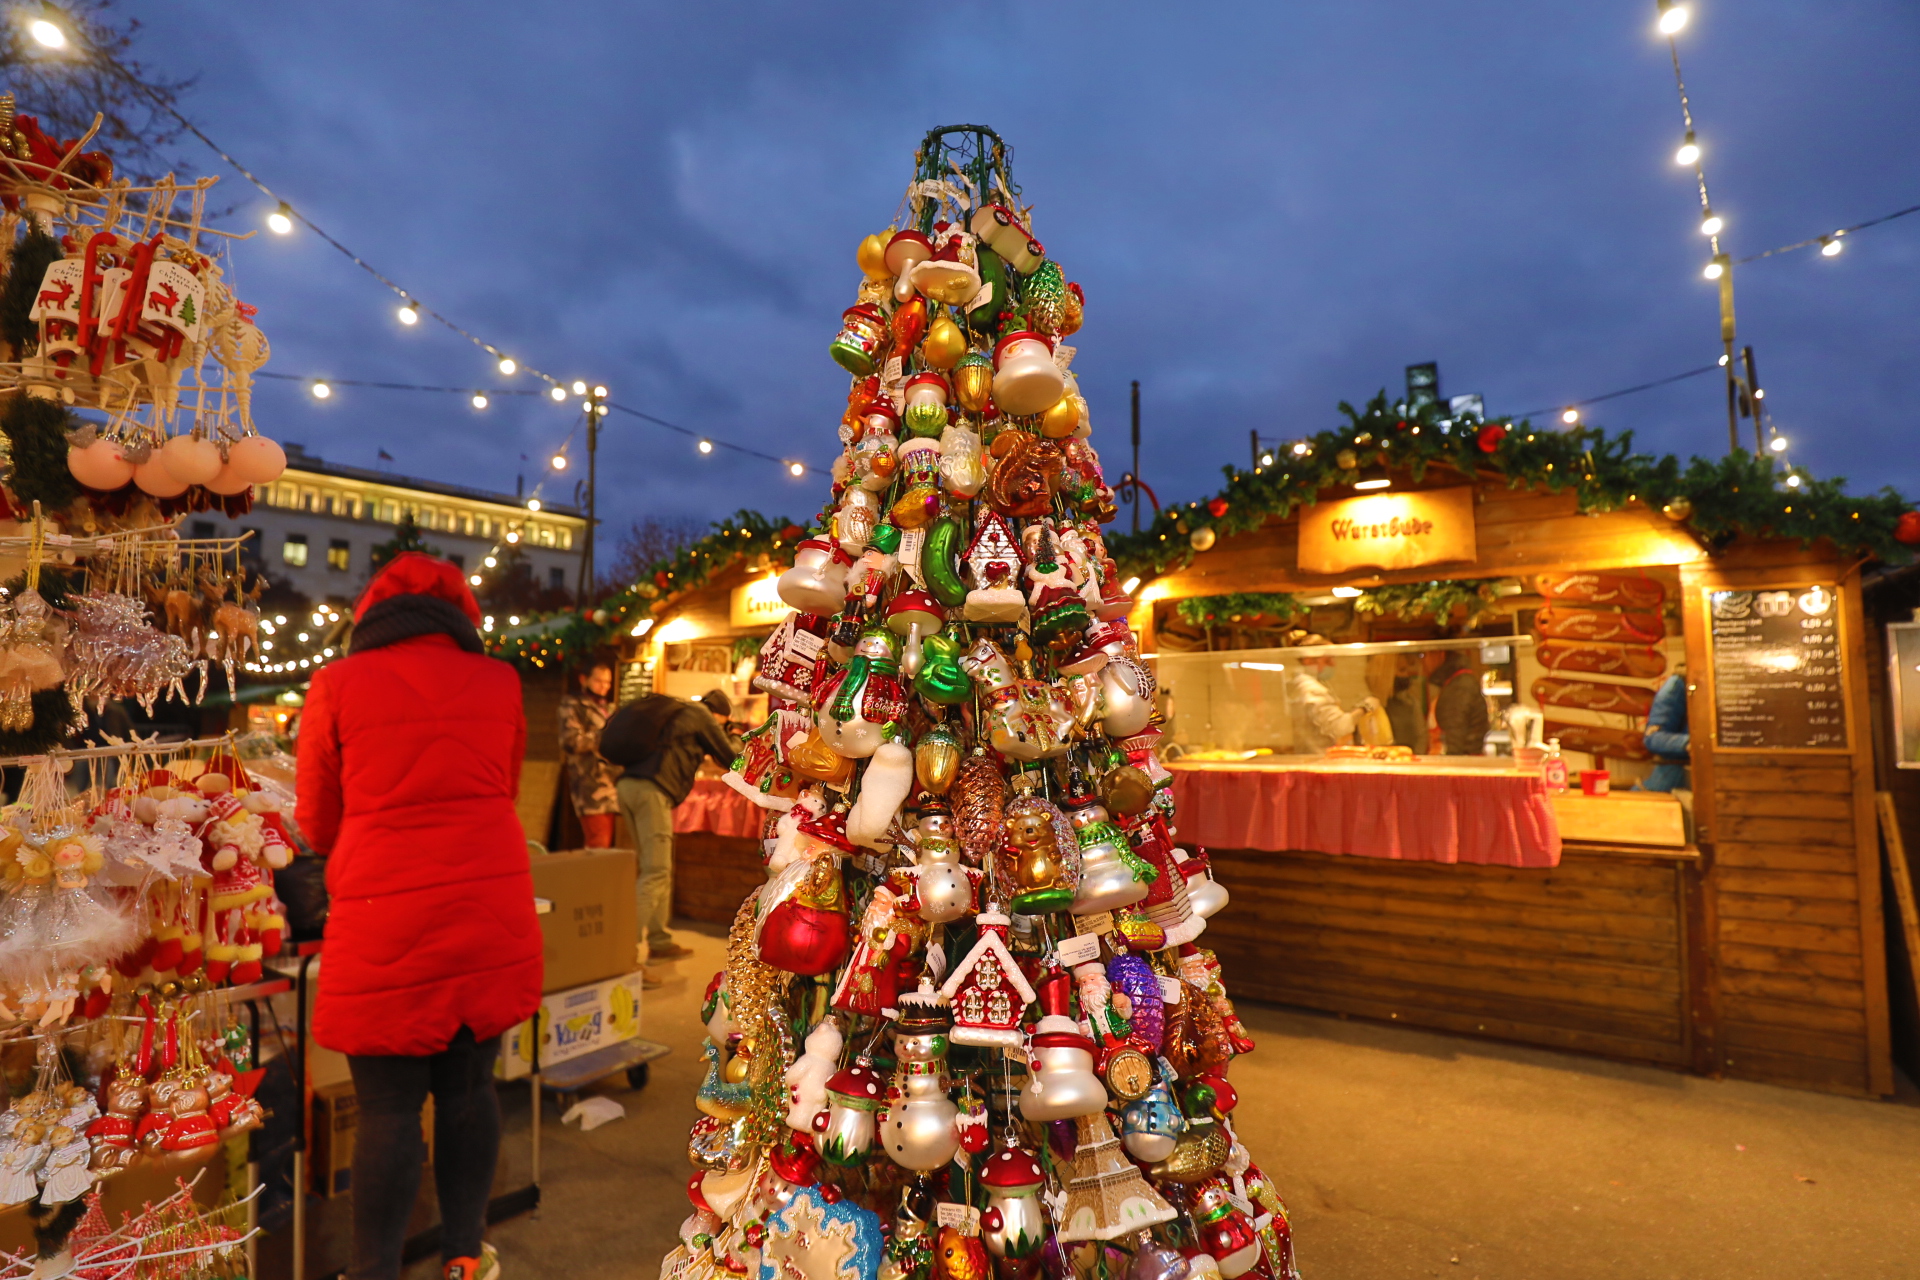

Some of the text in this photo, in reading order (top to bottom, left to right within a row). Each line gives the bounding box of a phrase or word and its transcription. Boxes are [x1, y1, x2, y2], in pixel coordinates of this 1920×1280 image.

[54, 268, 83, 279] Christ
[67, 265, 83, 274] Mer
[169, 269, 191, 284] Merry
[158, 269, 200, 294] Christmas
[794, 1230, 811, 1250] To:
